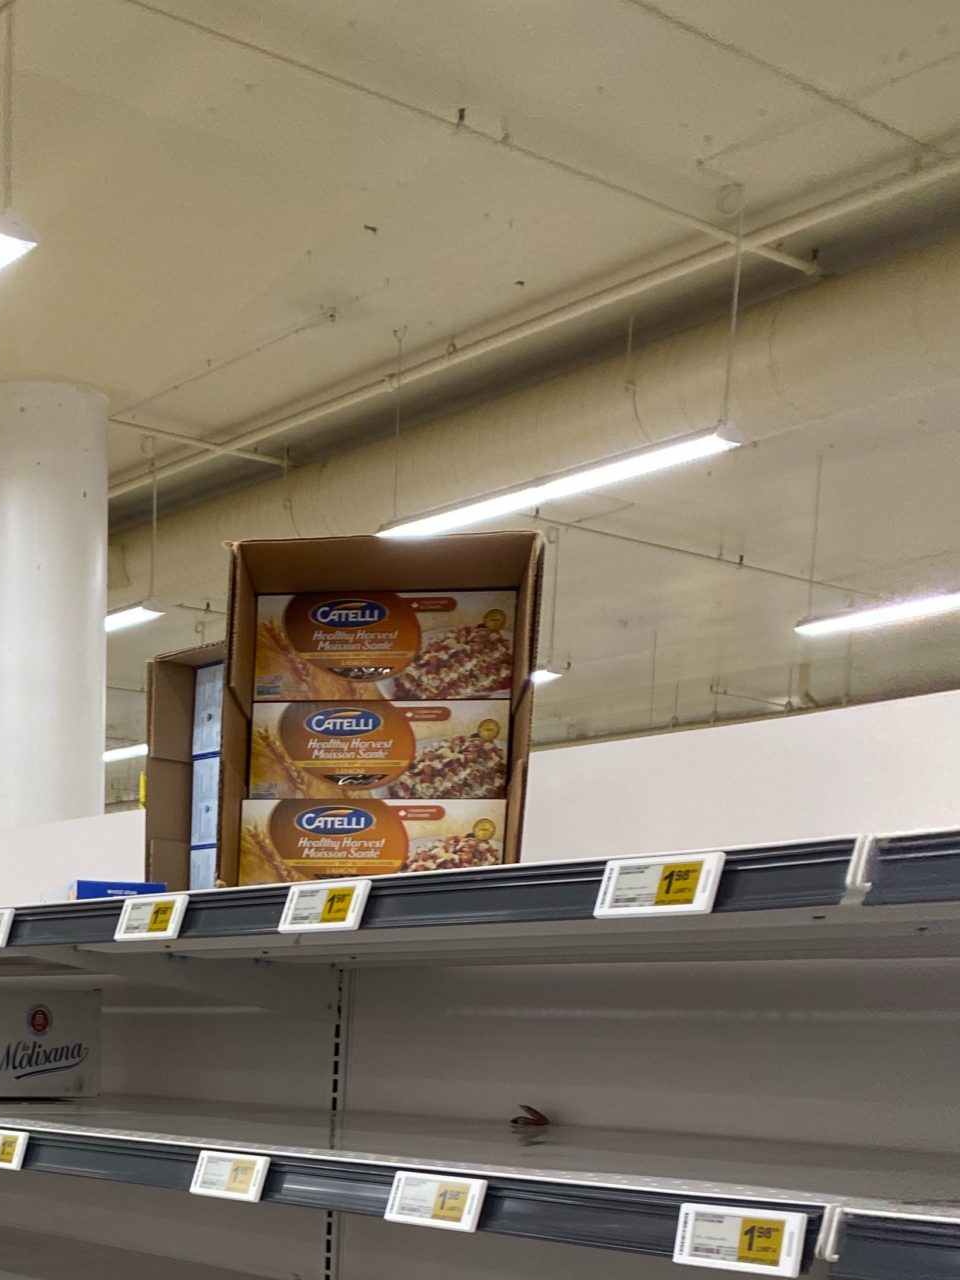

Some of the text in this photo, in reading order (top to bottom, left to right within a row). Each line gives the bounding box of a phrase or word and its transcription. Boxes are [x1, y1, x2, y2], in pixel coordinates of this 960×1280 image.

[316, 606, 379, 622] CATELLI
[312, 629, 399, 642] Healthy Harvest
[311, 715, 373, 731] CATELLI
[307, 738, 393, 751] Healthy Harvest
[311, 749, 355, 760] Moisson
[302, 813, 365, 829] CATELLI
[297, 837, 385, 850] Healthy Harvest
[302, 848, 349, 859] Moisson
